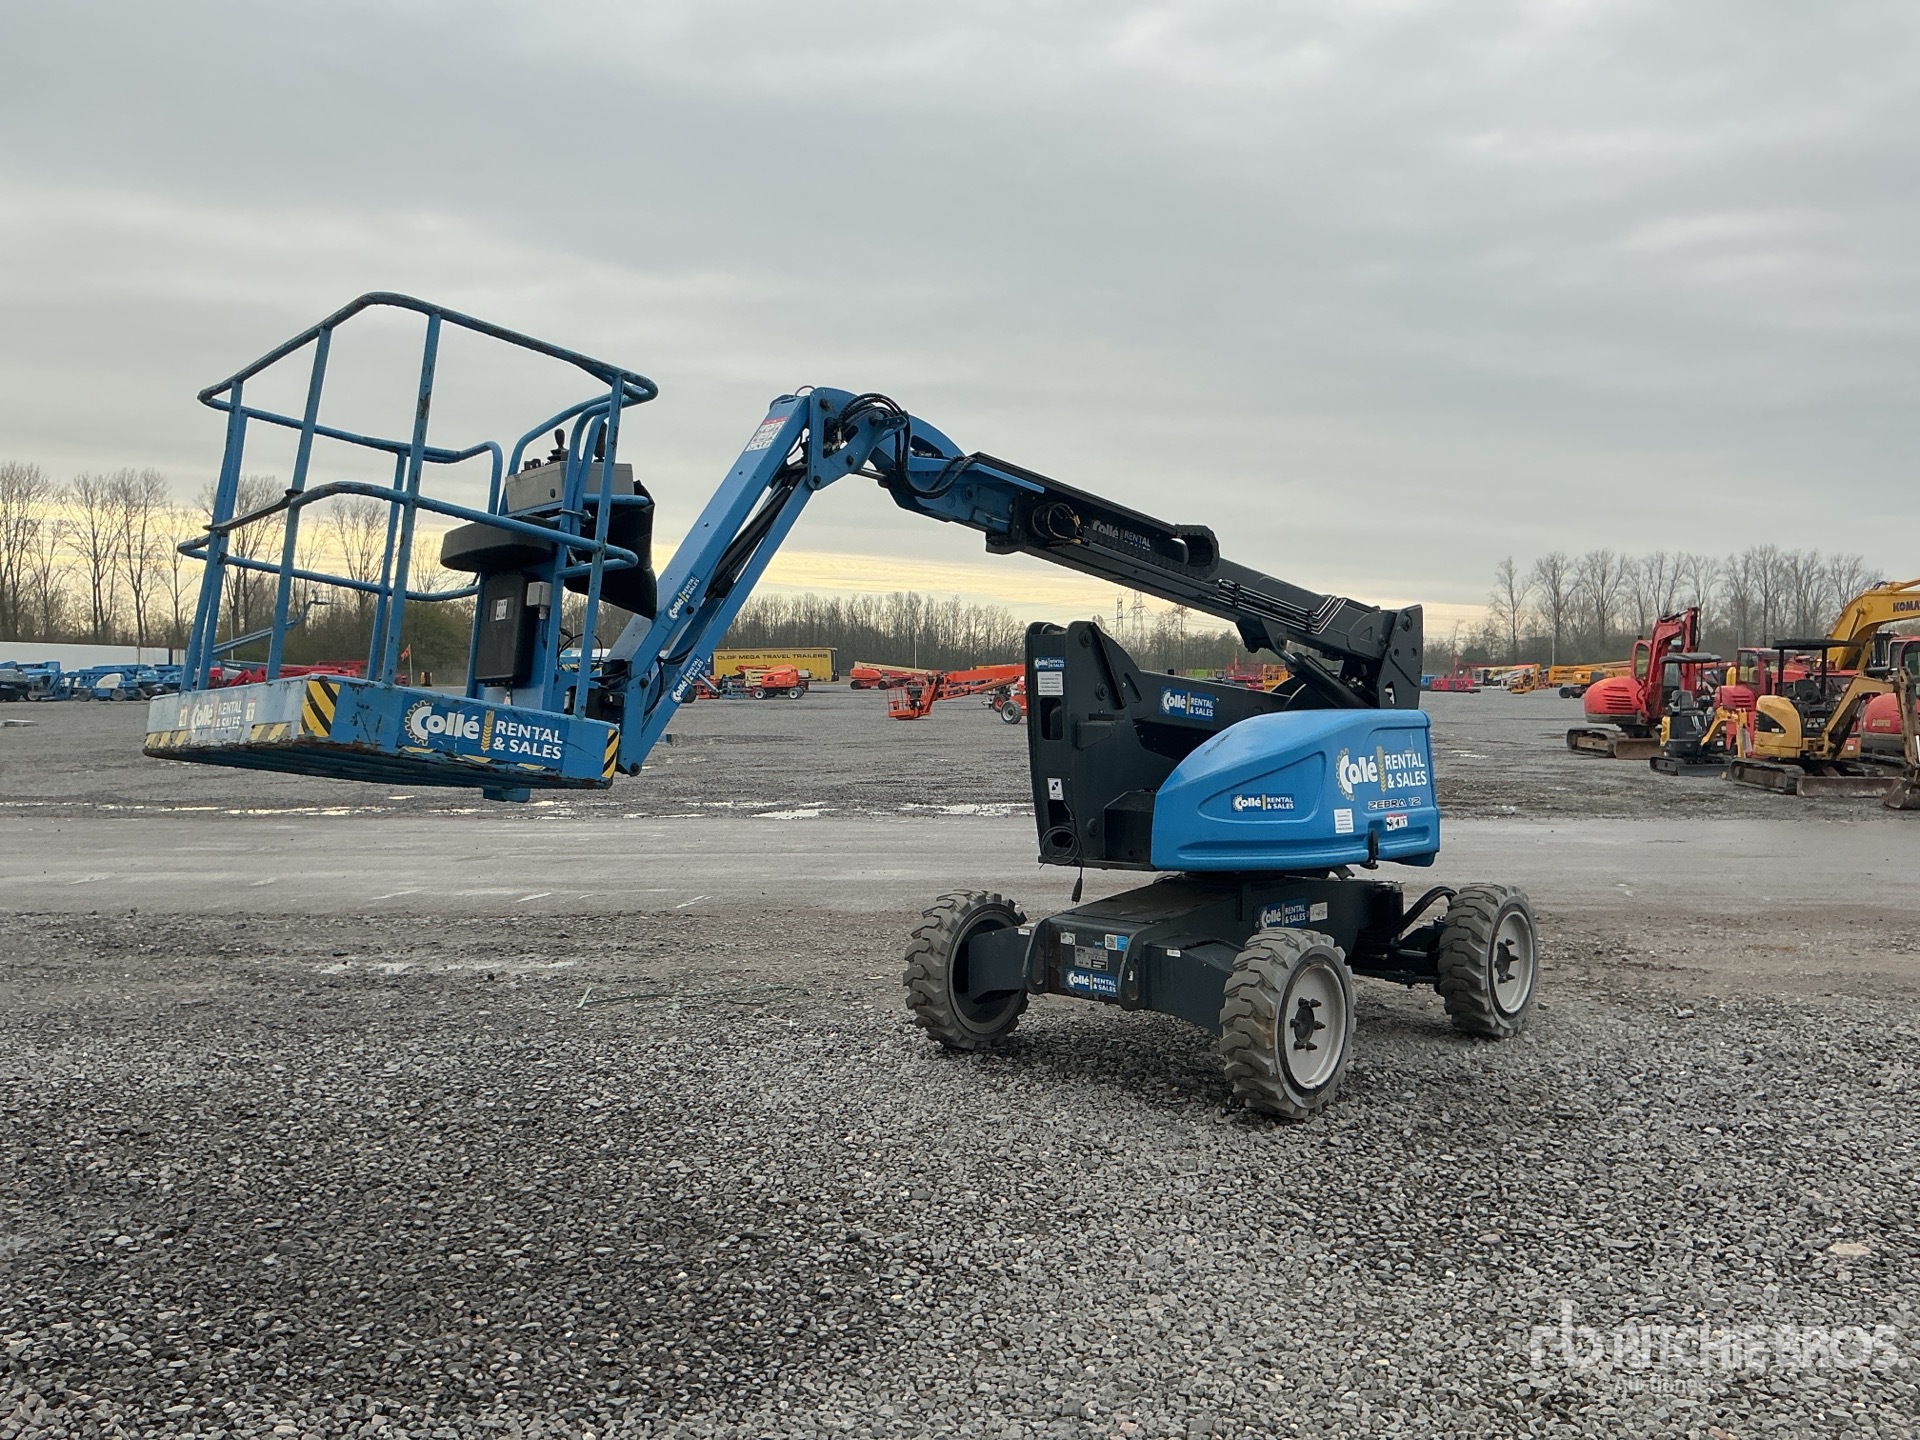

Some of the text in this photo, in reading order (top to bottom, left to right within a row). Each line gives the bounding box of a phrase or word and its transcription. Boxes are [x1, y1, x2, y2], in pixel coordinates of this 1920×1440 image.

[1124, 530, 1151, 547] RENTAL
[681, 576, 697, 596] RENTAL
[669, 597, 685, 619] Collé
[685, 657, 700, 677] RENTAL
[672, 679, 688, 702] Collé
[217, 701, 242, 715] RENTAL
[1163, 691, 1187, 711] Collé
[1190, 697, 1214, 709] RENTAL
[1190, 706, 1214, 717] & SALES
[221, 715, 241, 730] SALES
[410, 705, 480, 740] Collé
[495, 720, 563, 744] RENTAL
[492, 736, 562, 760] & SALES
[1384, 752, 1426, 770] RENTAL
[1339, 754, 1378, 794] Collé
[1387, 770, 1427, 789] & SALES
[1234, 796, 1262, 810] Collé
[1368, 796, 1421, 810] ZEBRA 12
[1261, 908, 1282, 928] Collé
[1285, 904, 1306, 915] RENTAL
[1289, 912, 1306, 923] SALES
[1068, 972, 1090, 986] Collé
[1093, 977, 1117, 987] RENTAL
[1098, 985, 1117, 993] SALES
